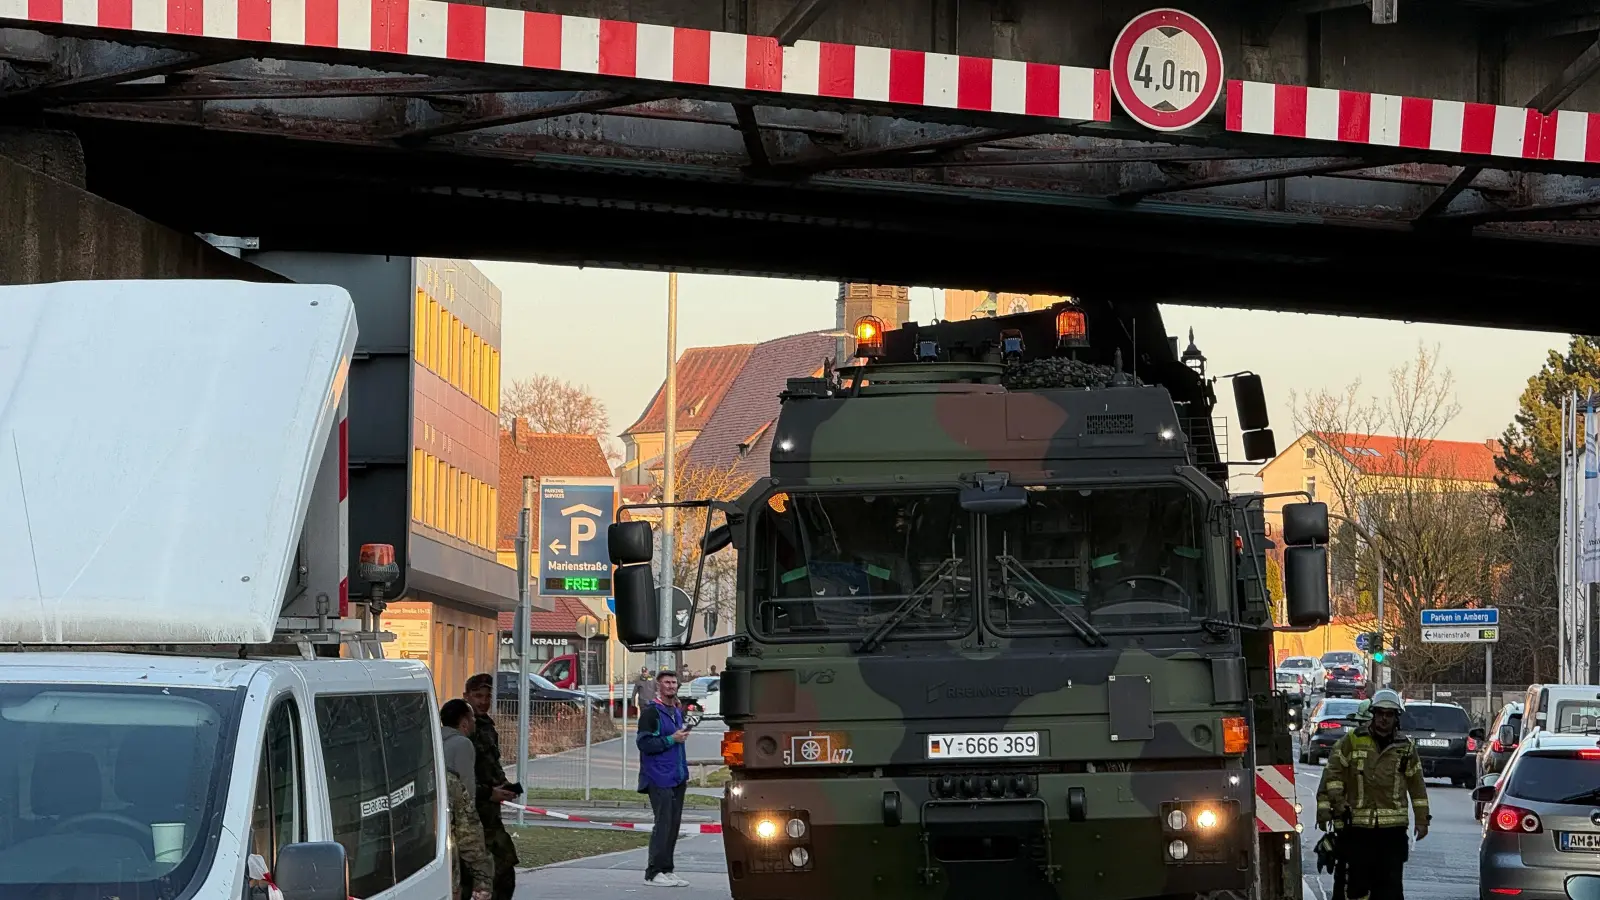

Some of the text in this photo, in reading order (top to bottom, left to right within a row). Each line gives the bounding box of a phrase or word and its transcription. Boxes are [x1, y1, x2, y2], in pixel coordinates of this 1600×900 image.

[570, 516, 597, 556] P
[548, 561, 608, 572] Marienstraße
[564, 577, 598, 591] FREI
[1430, 612, 1489, 622] Parken in Amberg
[532, 637, 568, 646] KRAUS
[1432, 631, 1471, 640] Marienstraße
[799, 669, 836, 684] V8
[946, 684, 1034, 699] RHEINMETALL
[1003, 735, 1036, 753] 369
[783, 750, 791, 766] 5
[831, 748, 854, 764] 472
[1570, 835, 1586, 847] AM
